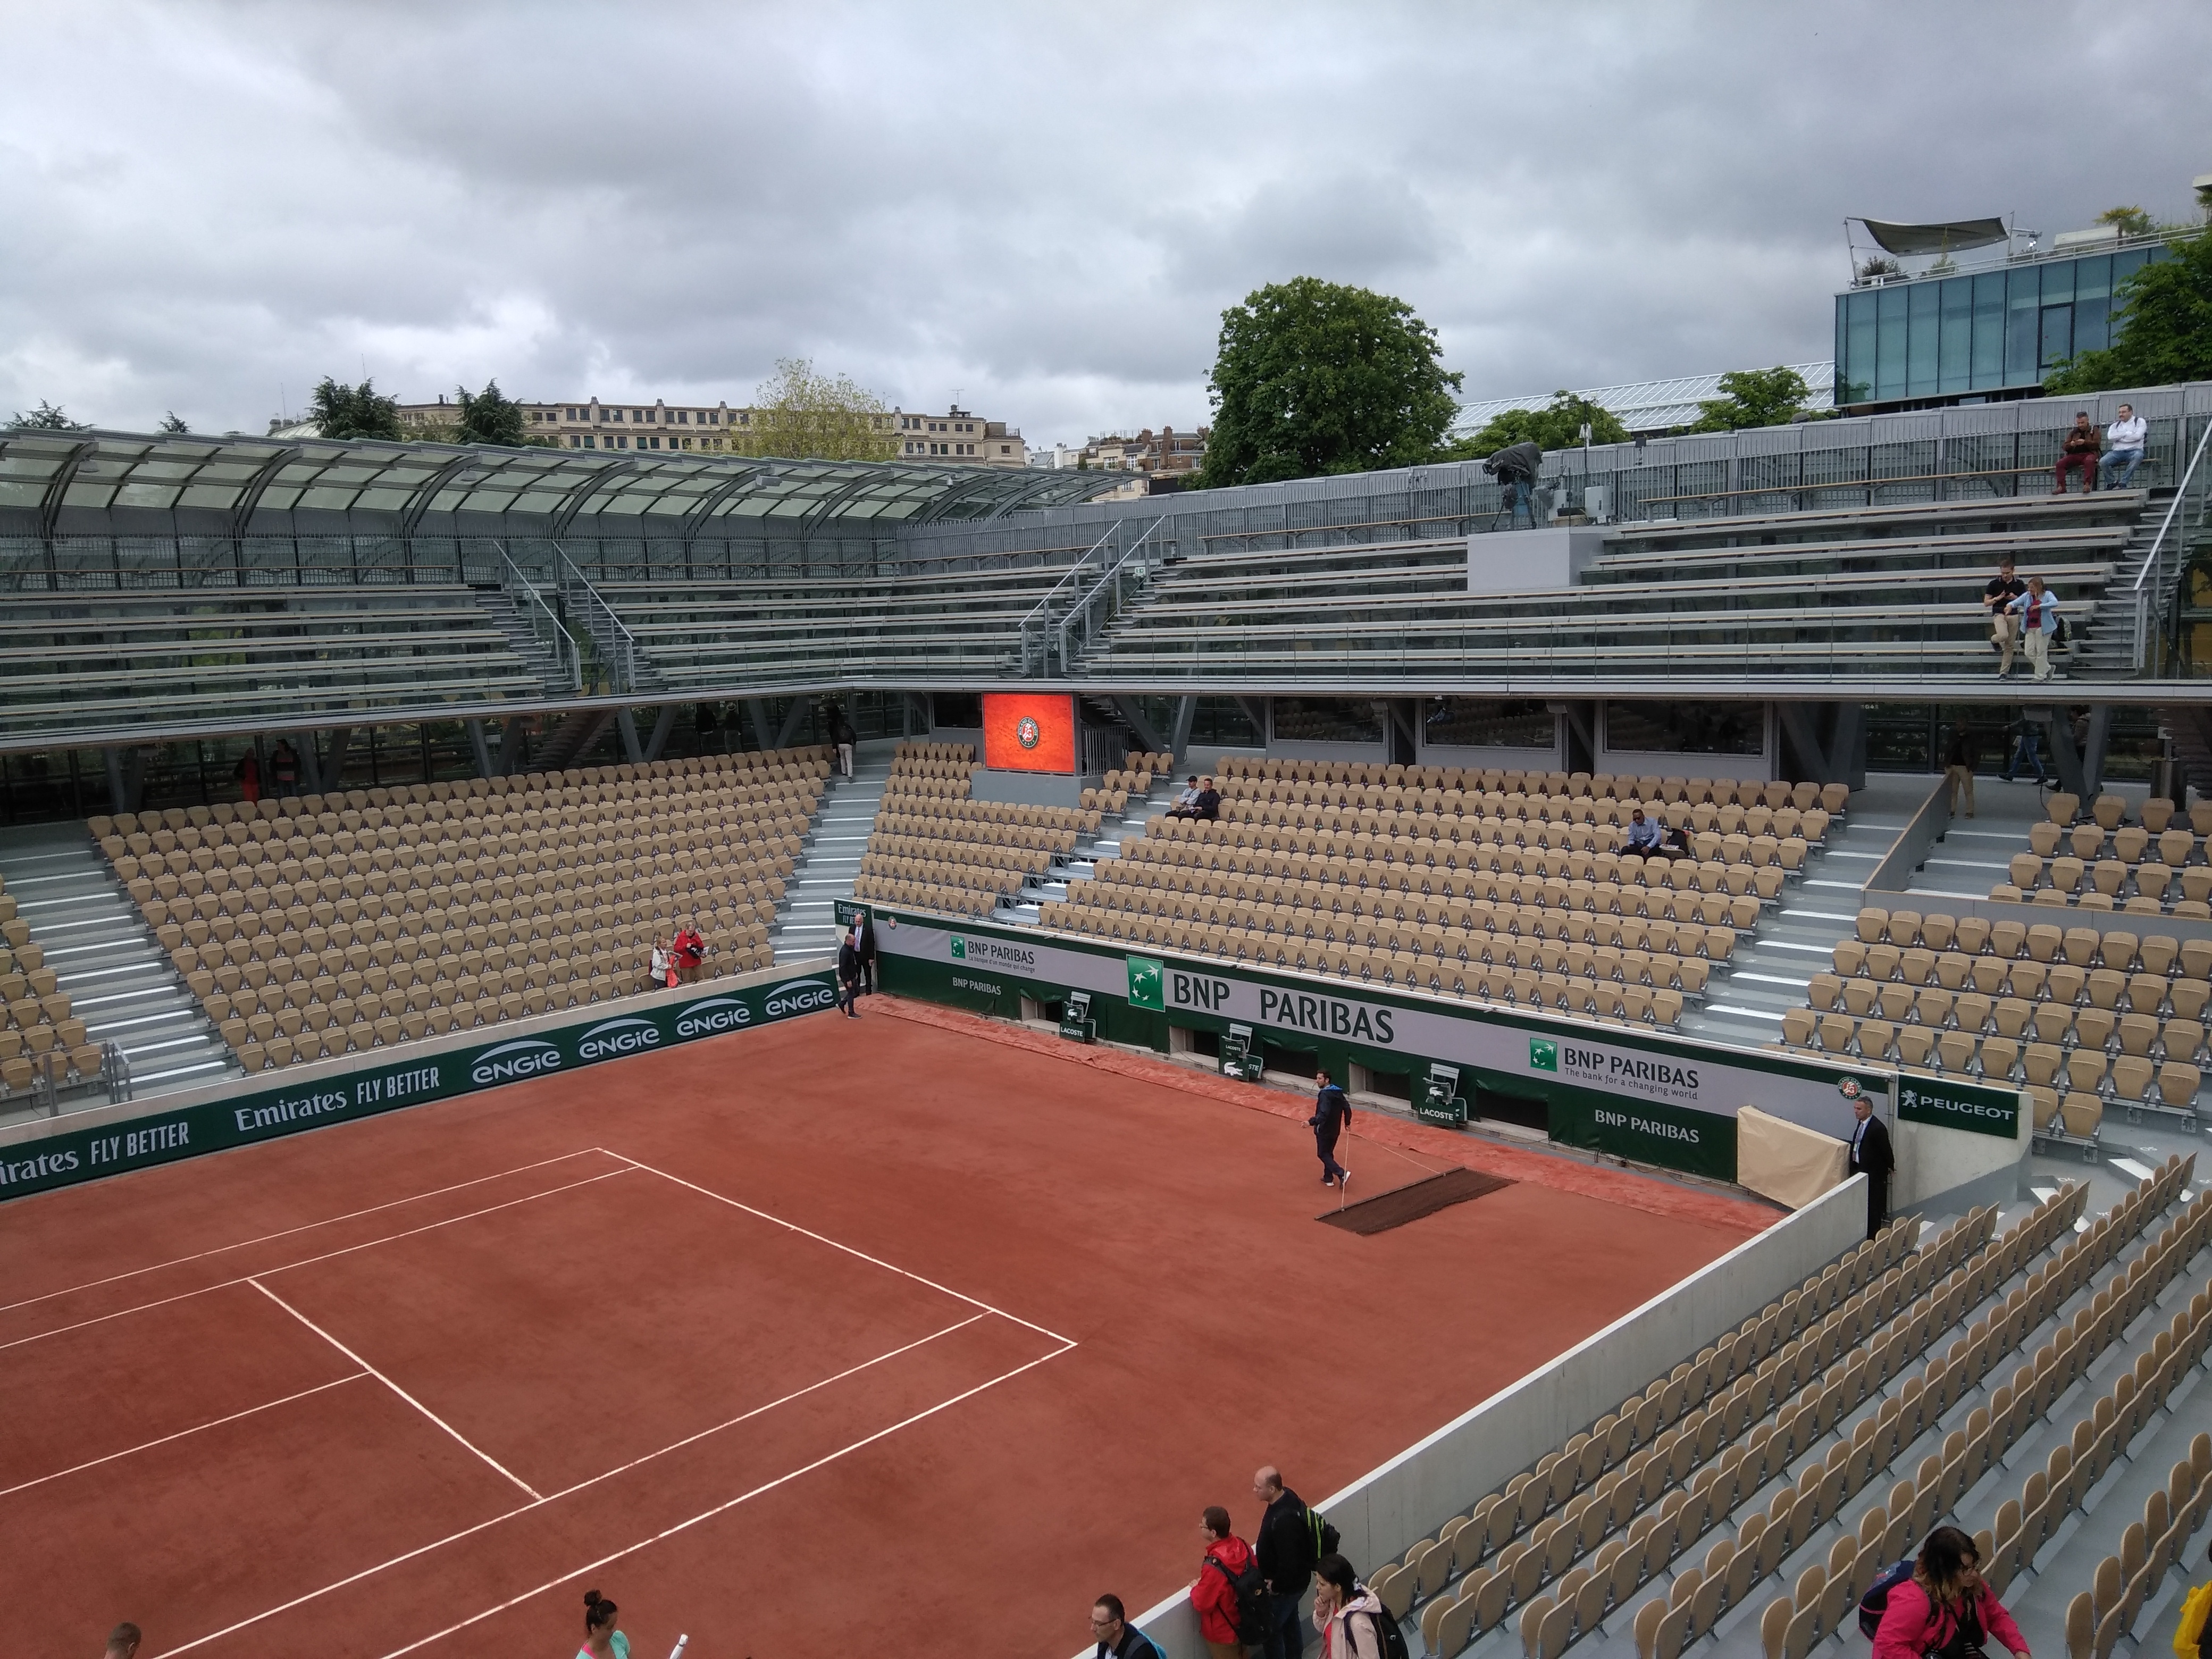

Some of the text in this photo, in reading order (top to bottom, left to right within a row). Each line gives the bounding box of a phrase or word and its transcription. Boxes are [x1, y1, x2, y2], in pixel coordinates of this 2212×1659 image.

[838, 903, 867, 918] Emirates
[968, 941, 1035, 965] BNP PARIBAS
[974, 956, 988, 965] banque
[1020, 966, 1035, 974] change
[952, 977, 1002, 995] BNP PARIBAS
[766, 989, 834, 1017] ENGIE
[1173, 974, 1395, 1044] BNP PARIBAS
[676, 1008, 751, 1037] ENGIE
[1061, 1026, 1083, 1037] LACOSTE
[579, 1027, 661, 1059] ENGIE
[472, 1049, 562, 1085] ENGIE
[1564, 1047, 1699, 1089] BNP PARIBAS
[1565, 1067, 1580, 1077] The
[1582, 1070, 1603, 1082] bank
[1605, 1075, 1618, 1085] for
[1628, 1080, 1668, 1096] changing
[1671, 1089, 1698, 1101] world
[234, 1066, 441, 1132] Emirates FLY BETTER
[1920, 1095, 2014, 1120] PEUGEOT
[1419, 1107, 1454, 1121] LACOSTE
[1595, 1109, 1700, 1143] BNP PARIBAS
[90, 1136, 120, 1165] FLY
[127, 1121, 190, 1158] BETTER
